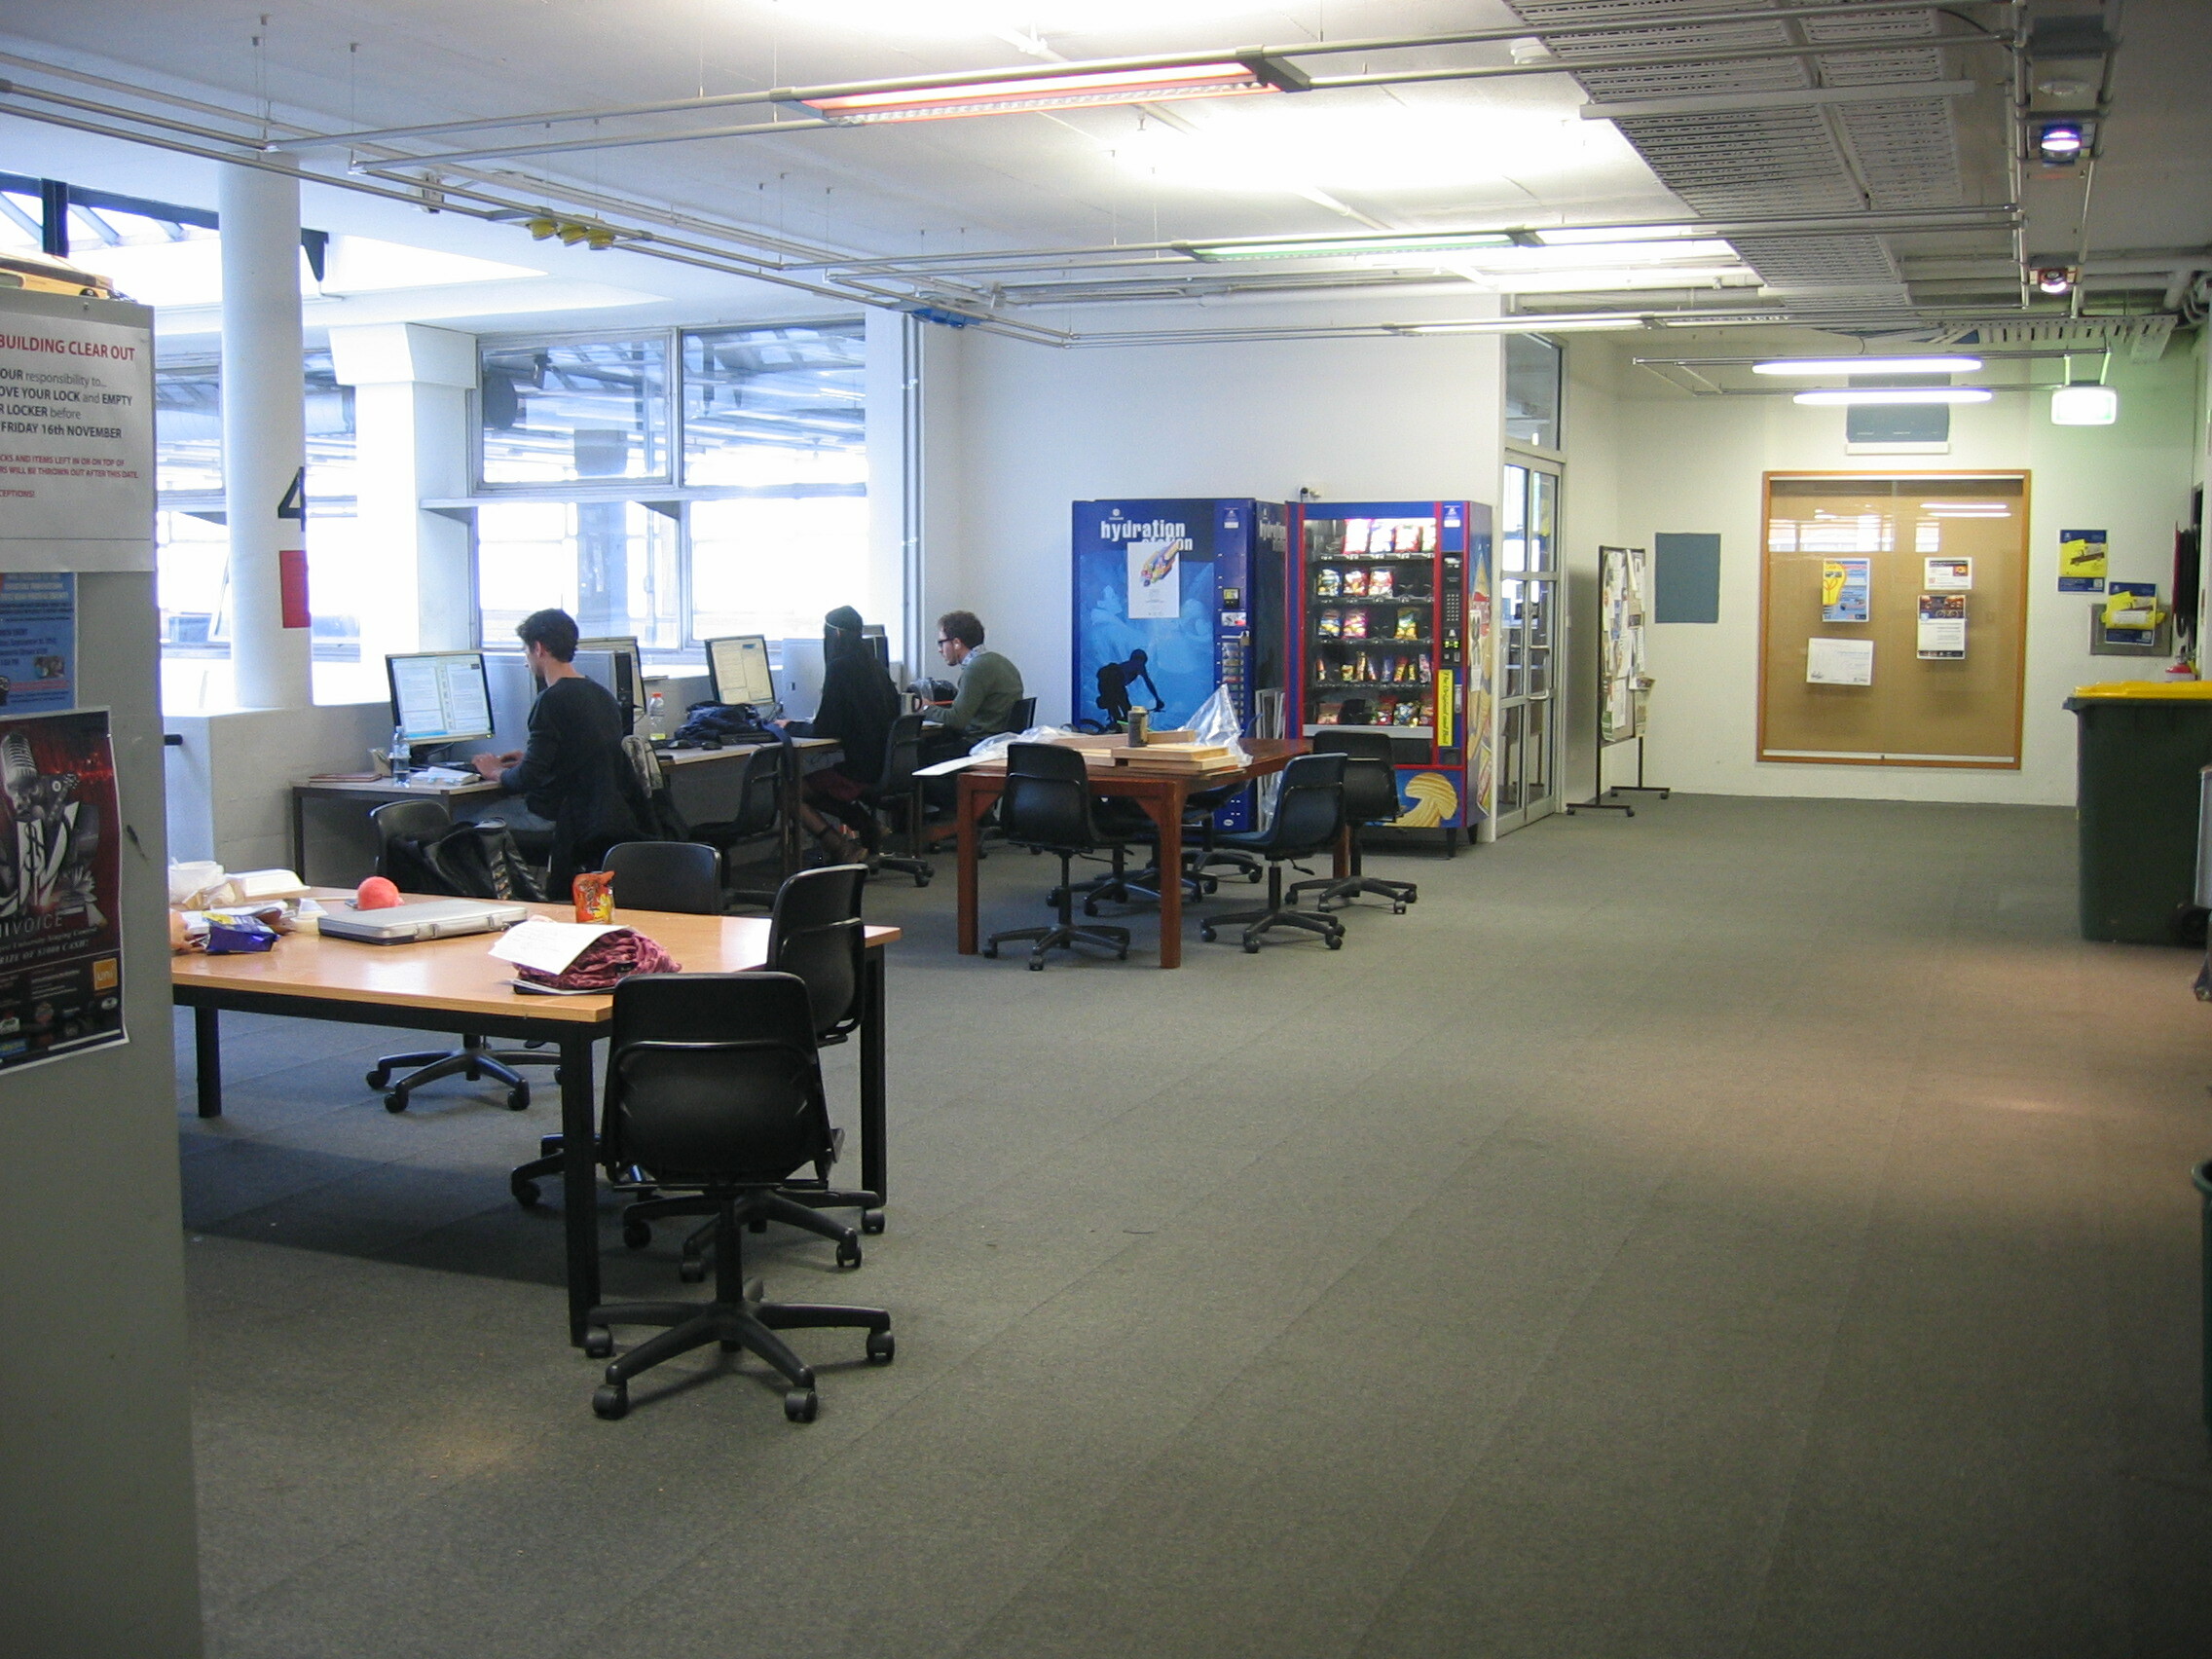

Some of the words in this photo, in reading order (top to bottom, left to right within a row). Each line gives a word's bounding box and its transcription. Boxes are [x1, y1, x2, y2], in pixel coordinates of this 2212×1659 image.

[0, 334, 65, 353] BUILDING
[68, 341, 108, 358] CLEAR
[111, 345, 135, 361] OUT
[25, 372, 90, 388] responsibility
[21, 387, 52, 400] YOUR
[54, 389, 80, 402] LOCK
[83, 392, 99, 404] and
[101, 393, 132, 407] EMPTY
[7, 404, 48, 418] LOCKER
[50, 407, 82, 420] before
[1, 421, 39, 434] FRIDAY
[42, 424, 65, 436] 16th
[67, 425, 123, 439] NOVEMBER
[16, 455, 31, 463] AND
[32, 456, 54, 464] ITEMS
[70, 468, 86, 477] OUT
[277, 465, 306, 532] 4
[1100, 519, 1185, 541] hydration
